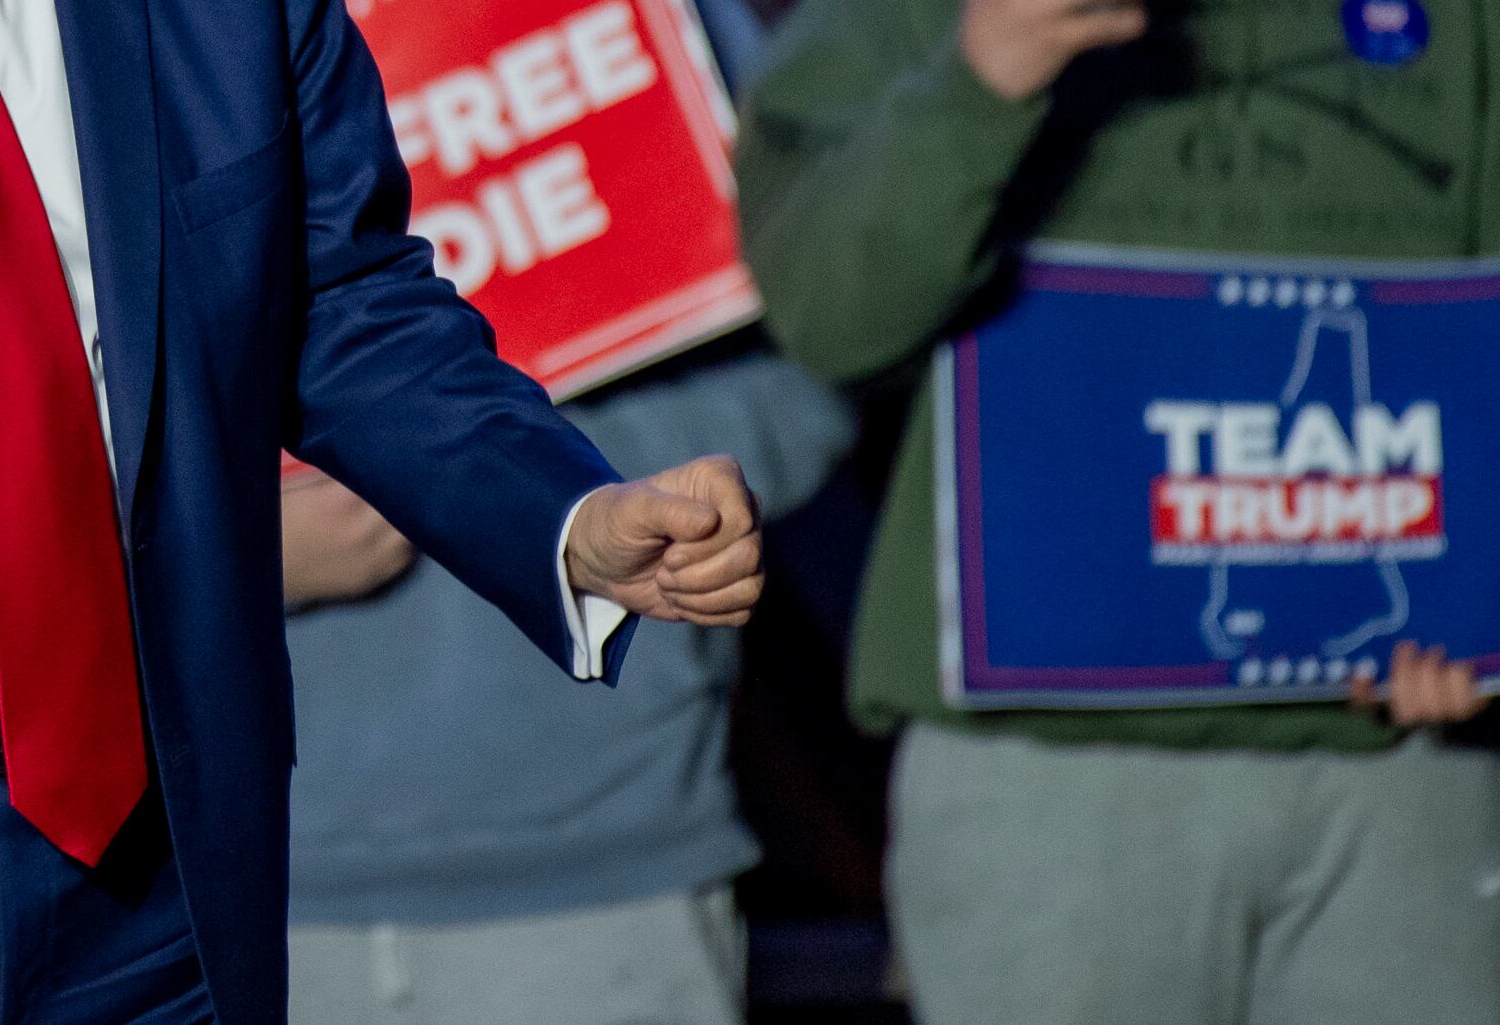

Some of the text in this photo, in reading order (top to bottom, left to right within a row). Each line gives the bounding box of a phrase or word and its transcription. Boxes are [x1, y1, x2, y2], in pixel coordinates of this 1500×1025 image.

[408, 143, 610, 297] DIE
[1145, 400, 1443, 476] TEAM
[1162, 475, 1436, 538] TRUMP
